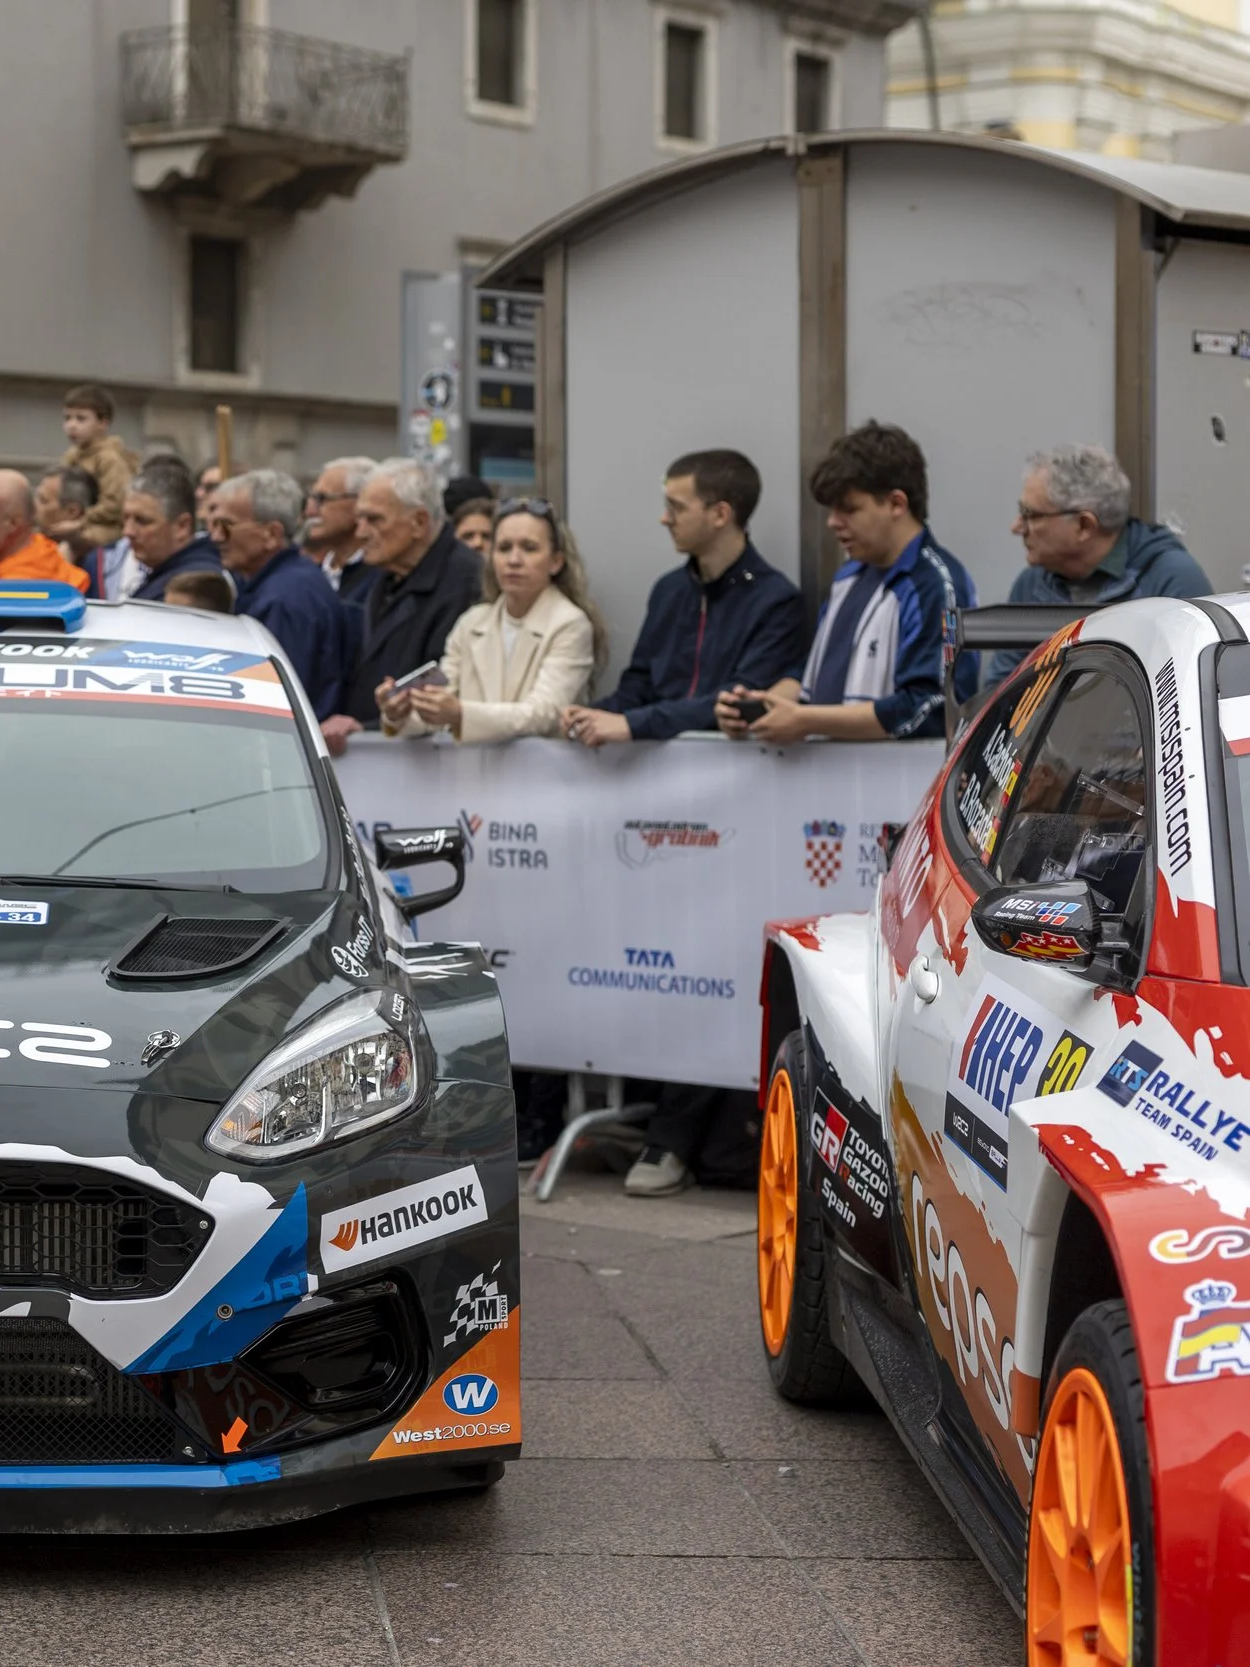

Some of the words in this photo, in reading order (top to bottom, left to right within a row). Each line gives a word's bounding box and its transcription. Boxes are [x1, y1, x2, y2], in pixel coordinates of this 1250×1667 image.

[1155, 657, 1192, 877] www.msispain.com
[489, 822, 538, 842] BINA
[488, 848, 549, 869] ISTRA
[7, 912, 36, 922] 34
[625, 947, 675, 969] TATA
[568, 966, 735, 999] COMMUNICATIONS
[1109, 1056, 1150, 1091] RTS
[1145, 1070, 1250, 1152] RALLYE
[810, 1112, 841, 1167] GR
[1135, 1097, 1172, 1130] TEAM
[1171, 1124, 1219, 1161] SPAIN
[843, 1147, 888, 1198] GAZOO
[822, 1177, 856, 1228] Spain
[839, 1163, 885, 1219] Racing
[479, 1322, 509, 1331] POLAND
[451, 1377, 494, 1409] W
[393, 1422, 511, 1444] West2000.se
